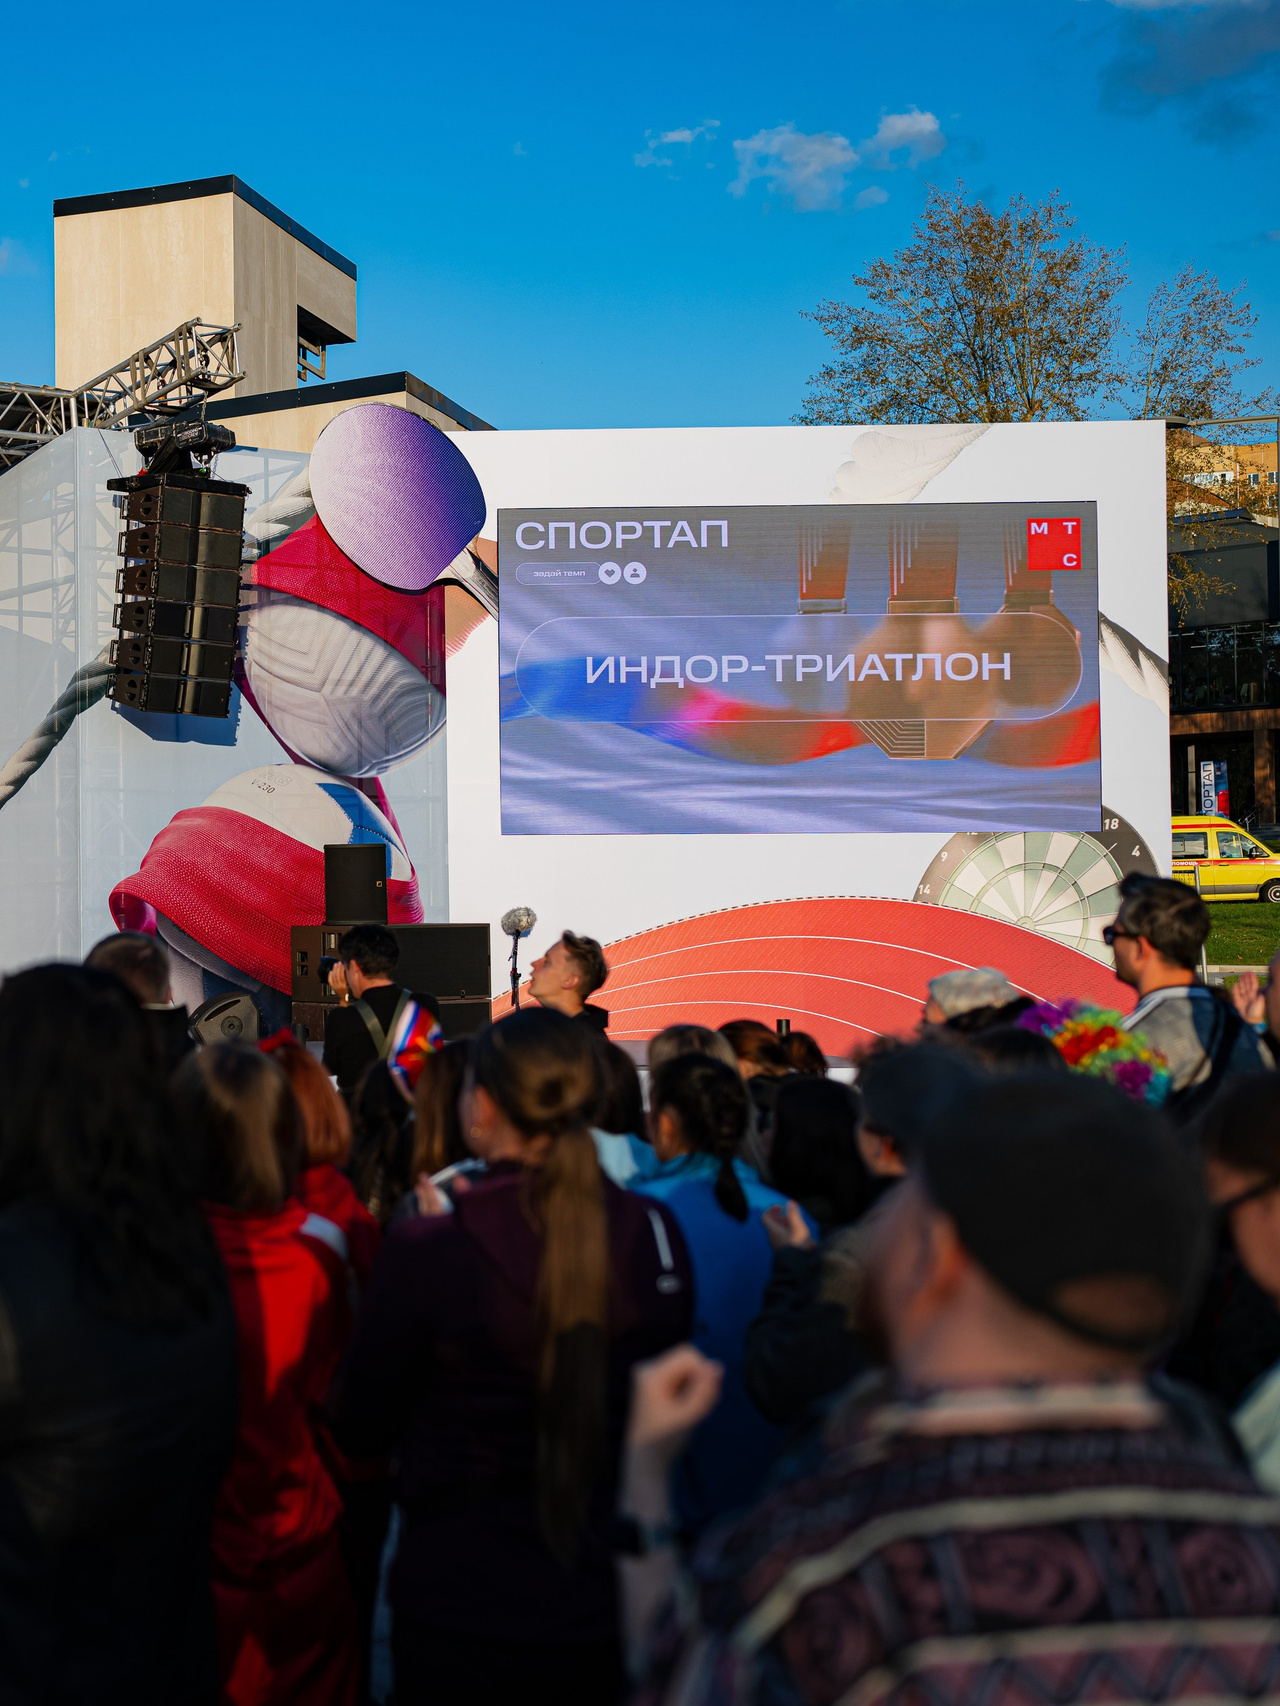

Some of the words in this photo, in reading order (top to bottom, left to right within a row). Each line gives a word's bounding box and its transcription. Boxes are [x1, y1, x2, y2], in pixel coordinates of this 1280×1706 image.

[1030, 522, 1048, 535] М
[1062, 521, 1077, 535] Т
[515, 520, 729, 550] СПОРТАП
[1062, 553, 1077, 567] С
[533, 568, 562, 577] задай
[563, 569, 586, 577] темп
[586, 653, 1011, 689] ИНДОР-ТРИАТЛОН
[1103, 818, 1120, 830] 18
[940, 851, 948, 862] 9
[1131, 845, 1141, 857] 4
[918, 884, 931, 895] 14
